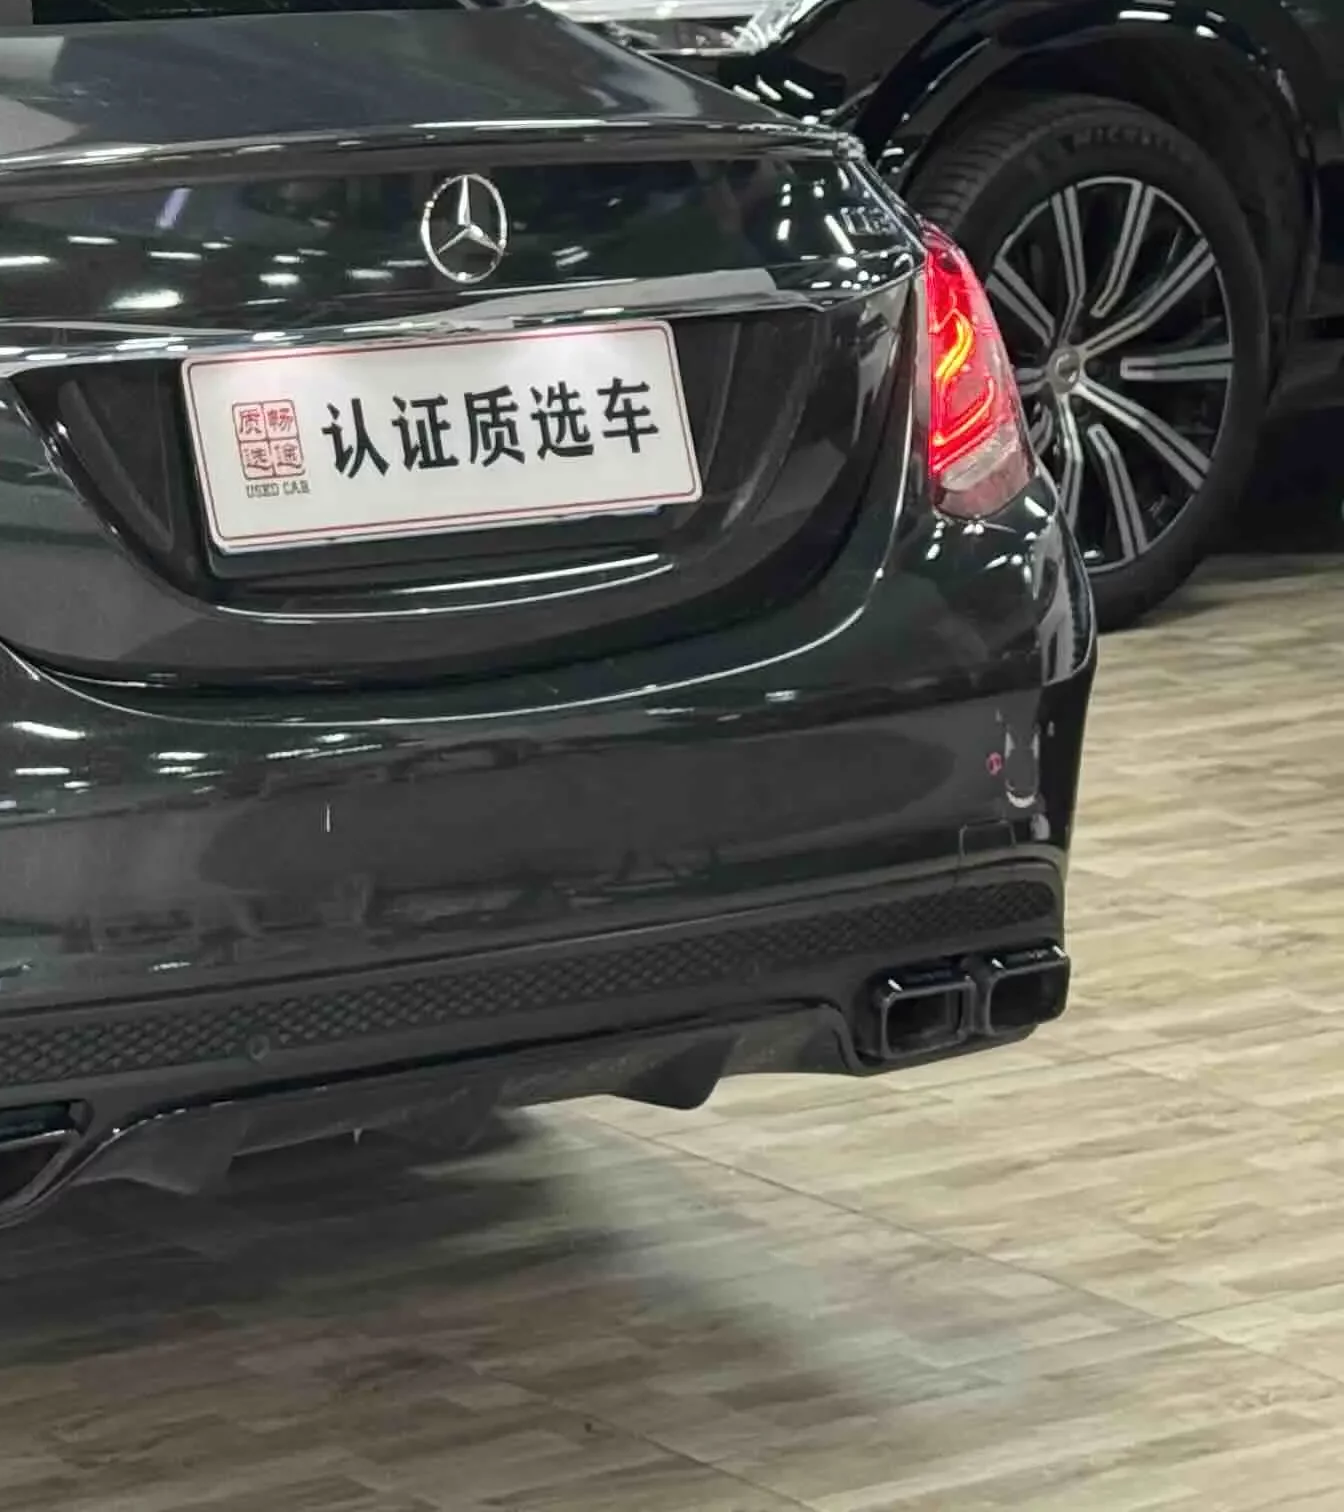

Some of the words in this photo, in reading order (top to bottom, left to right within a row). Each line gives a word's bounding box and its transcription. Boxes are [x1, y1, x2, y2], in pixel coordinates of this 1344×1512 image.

[322, 377, 660, 479] 认证质选车
